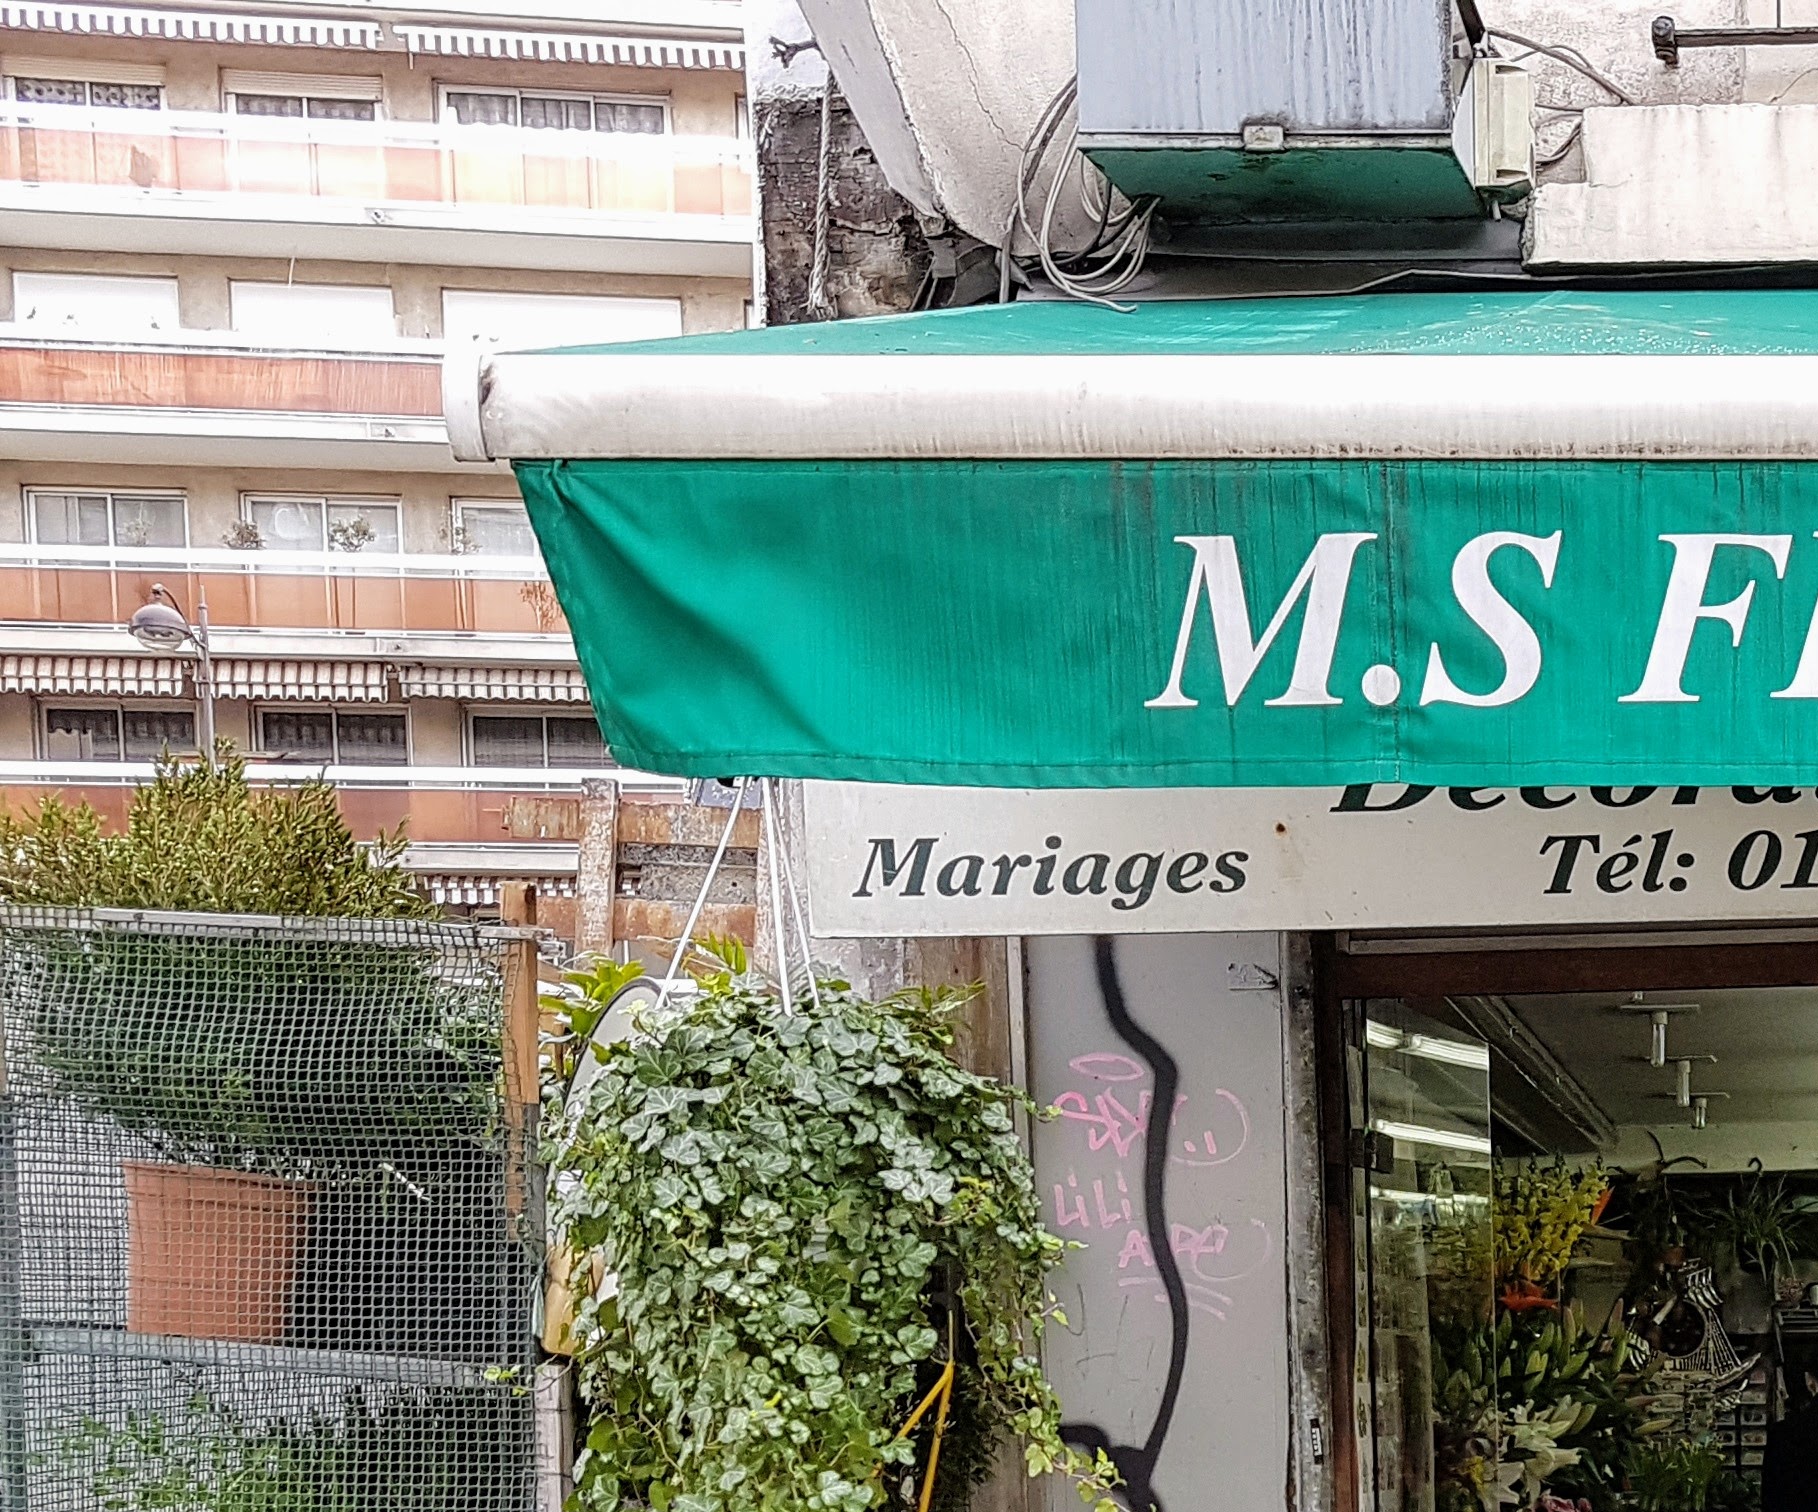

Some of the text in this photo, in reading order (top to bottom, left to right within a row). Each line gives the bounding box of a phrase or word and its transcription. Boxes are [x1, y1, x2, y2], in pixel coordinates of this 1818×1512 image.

[1144, 530, 1562, 706] M.S
[851, 835, 1250, 911] Mariages
[1539, 828, 1695, 894] Tél:
